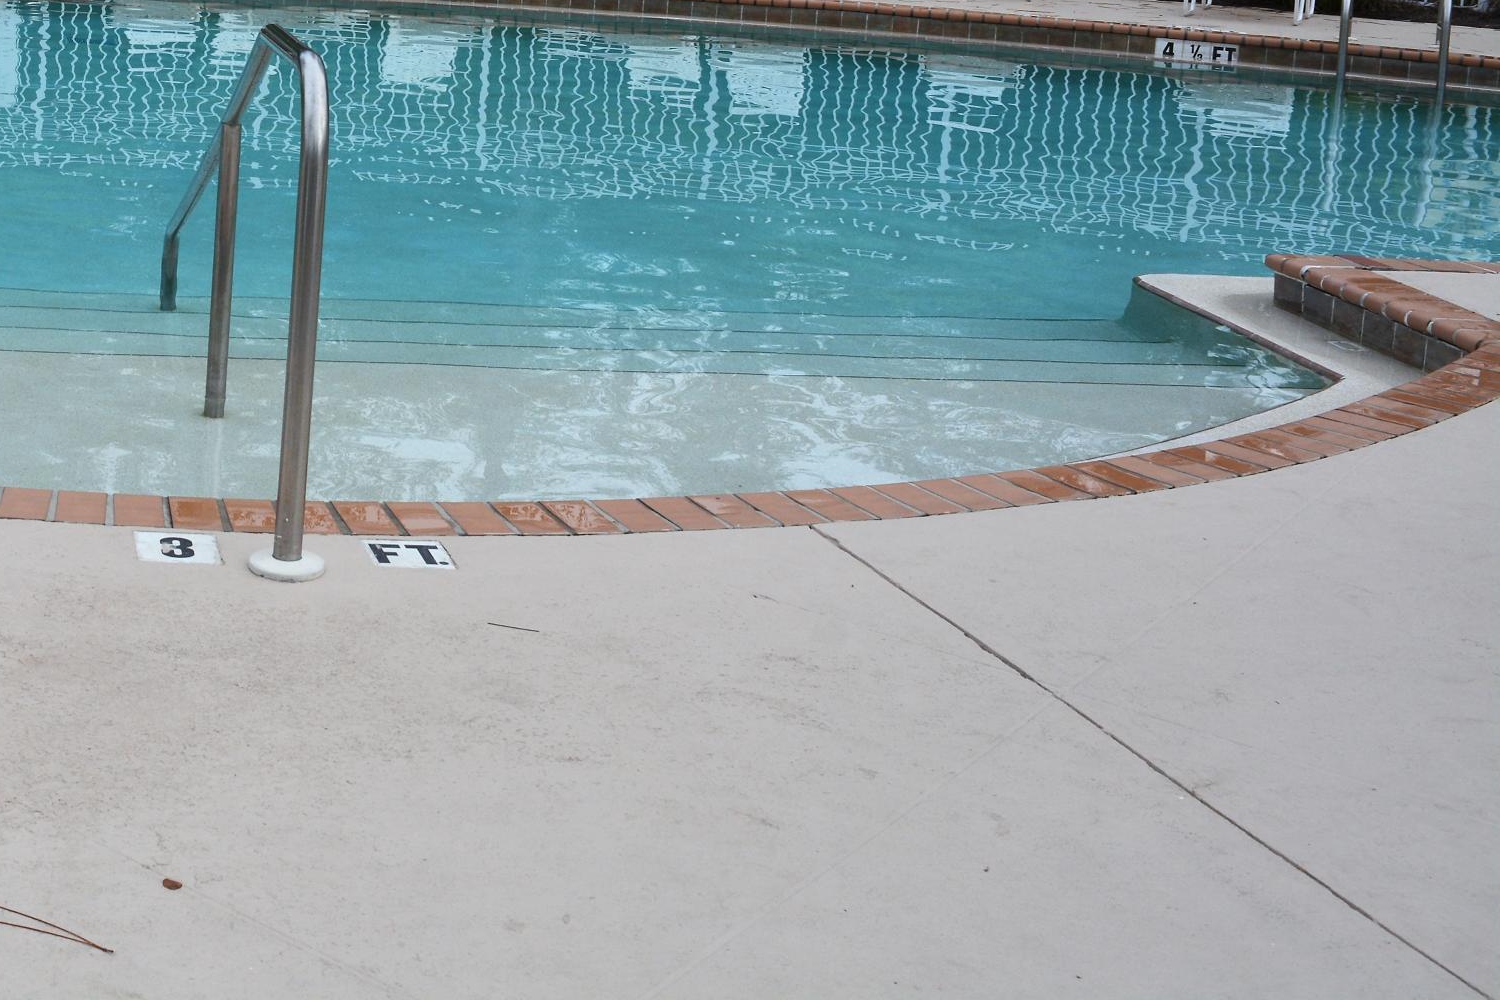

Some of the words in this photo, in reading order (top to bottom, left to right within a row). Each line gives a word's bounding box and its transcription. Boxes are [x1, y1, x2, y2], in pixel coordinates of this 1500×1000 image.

[1162, 41, 1175, 57] 4
[1212, 46, 1237, 62] FT
[159, 536, 195, 559] 3
